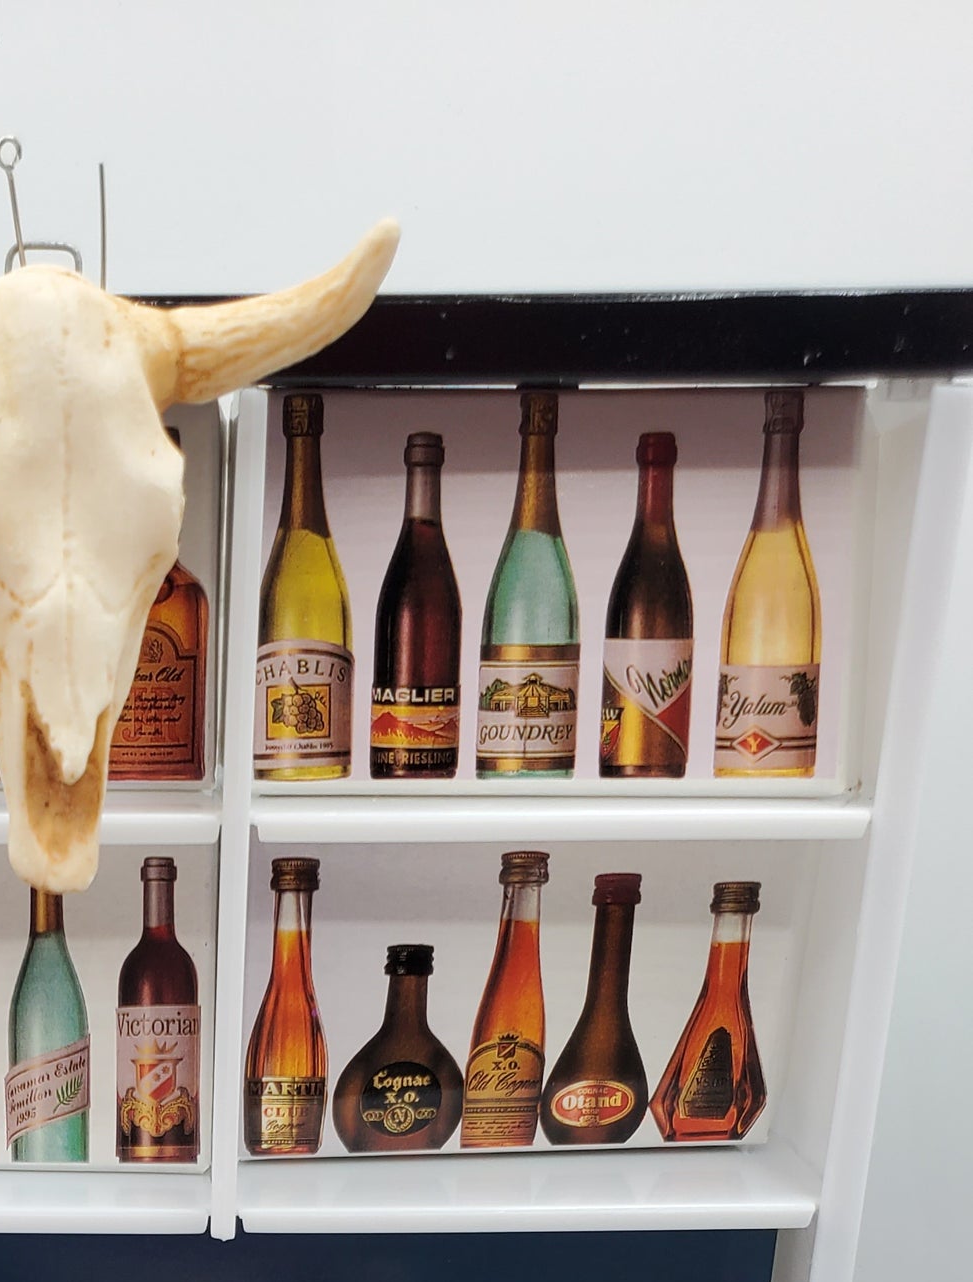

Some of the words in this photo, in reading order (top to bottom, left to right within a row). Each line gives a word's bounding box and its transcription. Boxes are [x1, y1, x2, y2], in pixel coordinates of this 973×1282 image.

[256, 659, 347, 685] CHABLIS
[479, 724, 573, 745] GOUNDREY
[492, 1061, 521, 1071] X.O.
[373, 1070, 431, 1091] Cognac
[562, 1092, 622, 1110] Otand
